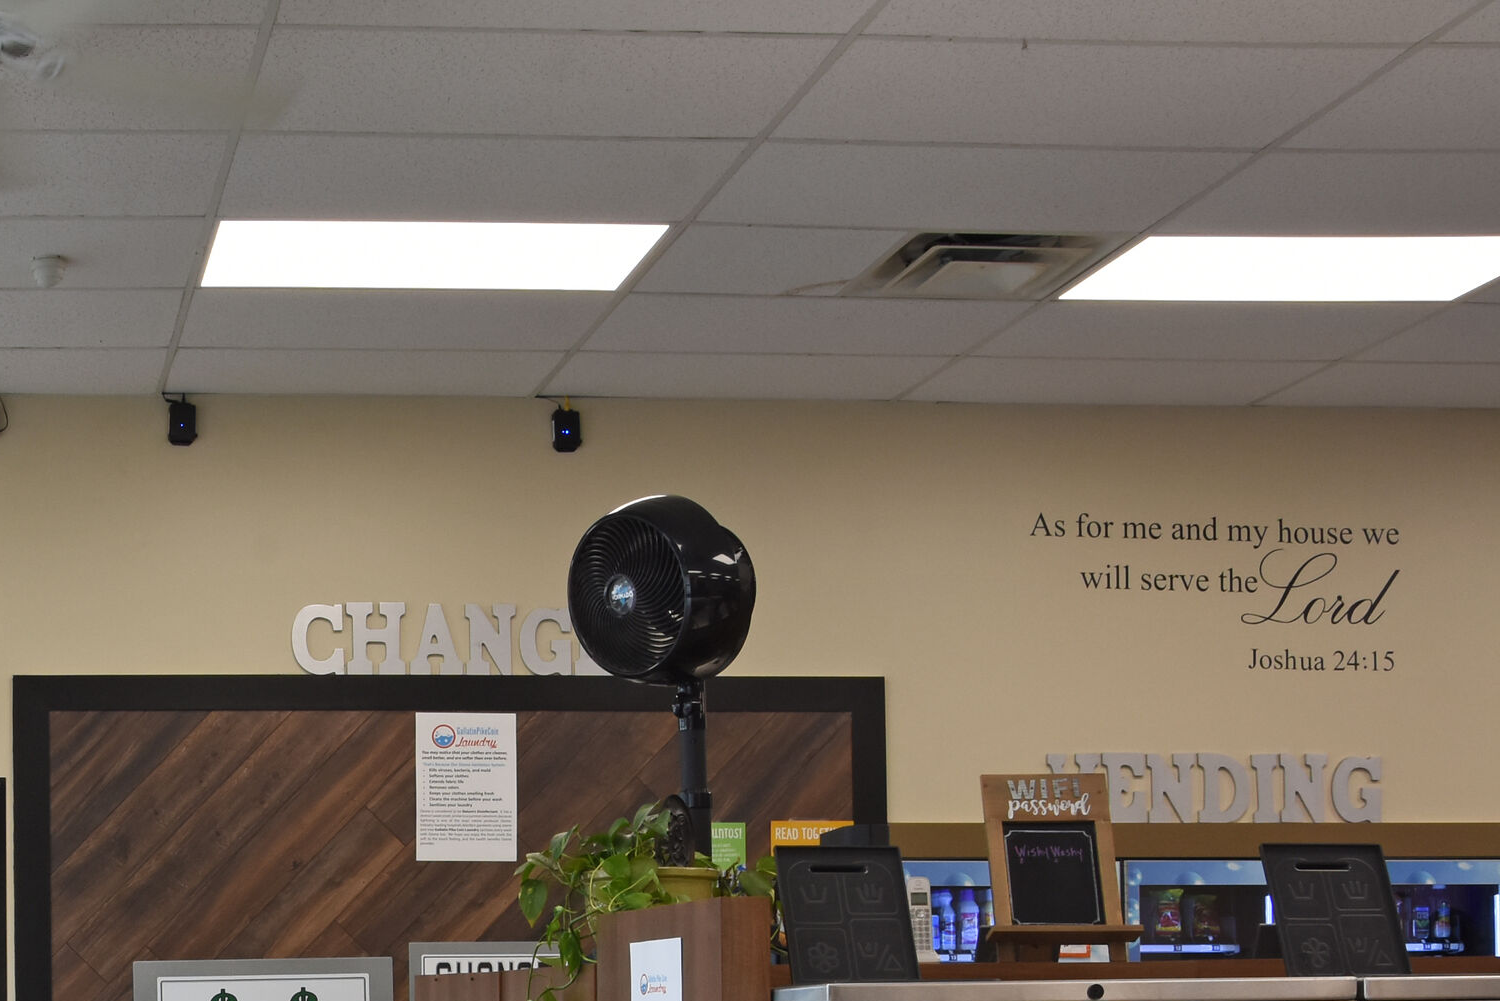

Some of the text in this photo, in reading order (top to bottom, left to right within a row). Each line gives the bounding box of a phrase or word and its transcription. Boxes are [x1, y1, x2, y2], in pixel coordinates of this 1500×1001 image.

[1030, 512, 1399, 548] As for me and my house we
[1081, 548, 1400, 625] will serve the Lord
[291, 601, 614, 676] CHANG
[1248, 649, 1394, 671] Joshua 24:15
[455, 737, 497, 748] Laundry
[1007, 778, 1081, 800] WIFI
[1007, 792, 1091, 819] password
[775, 827, 799, 840] READ
